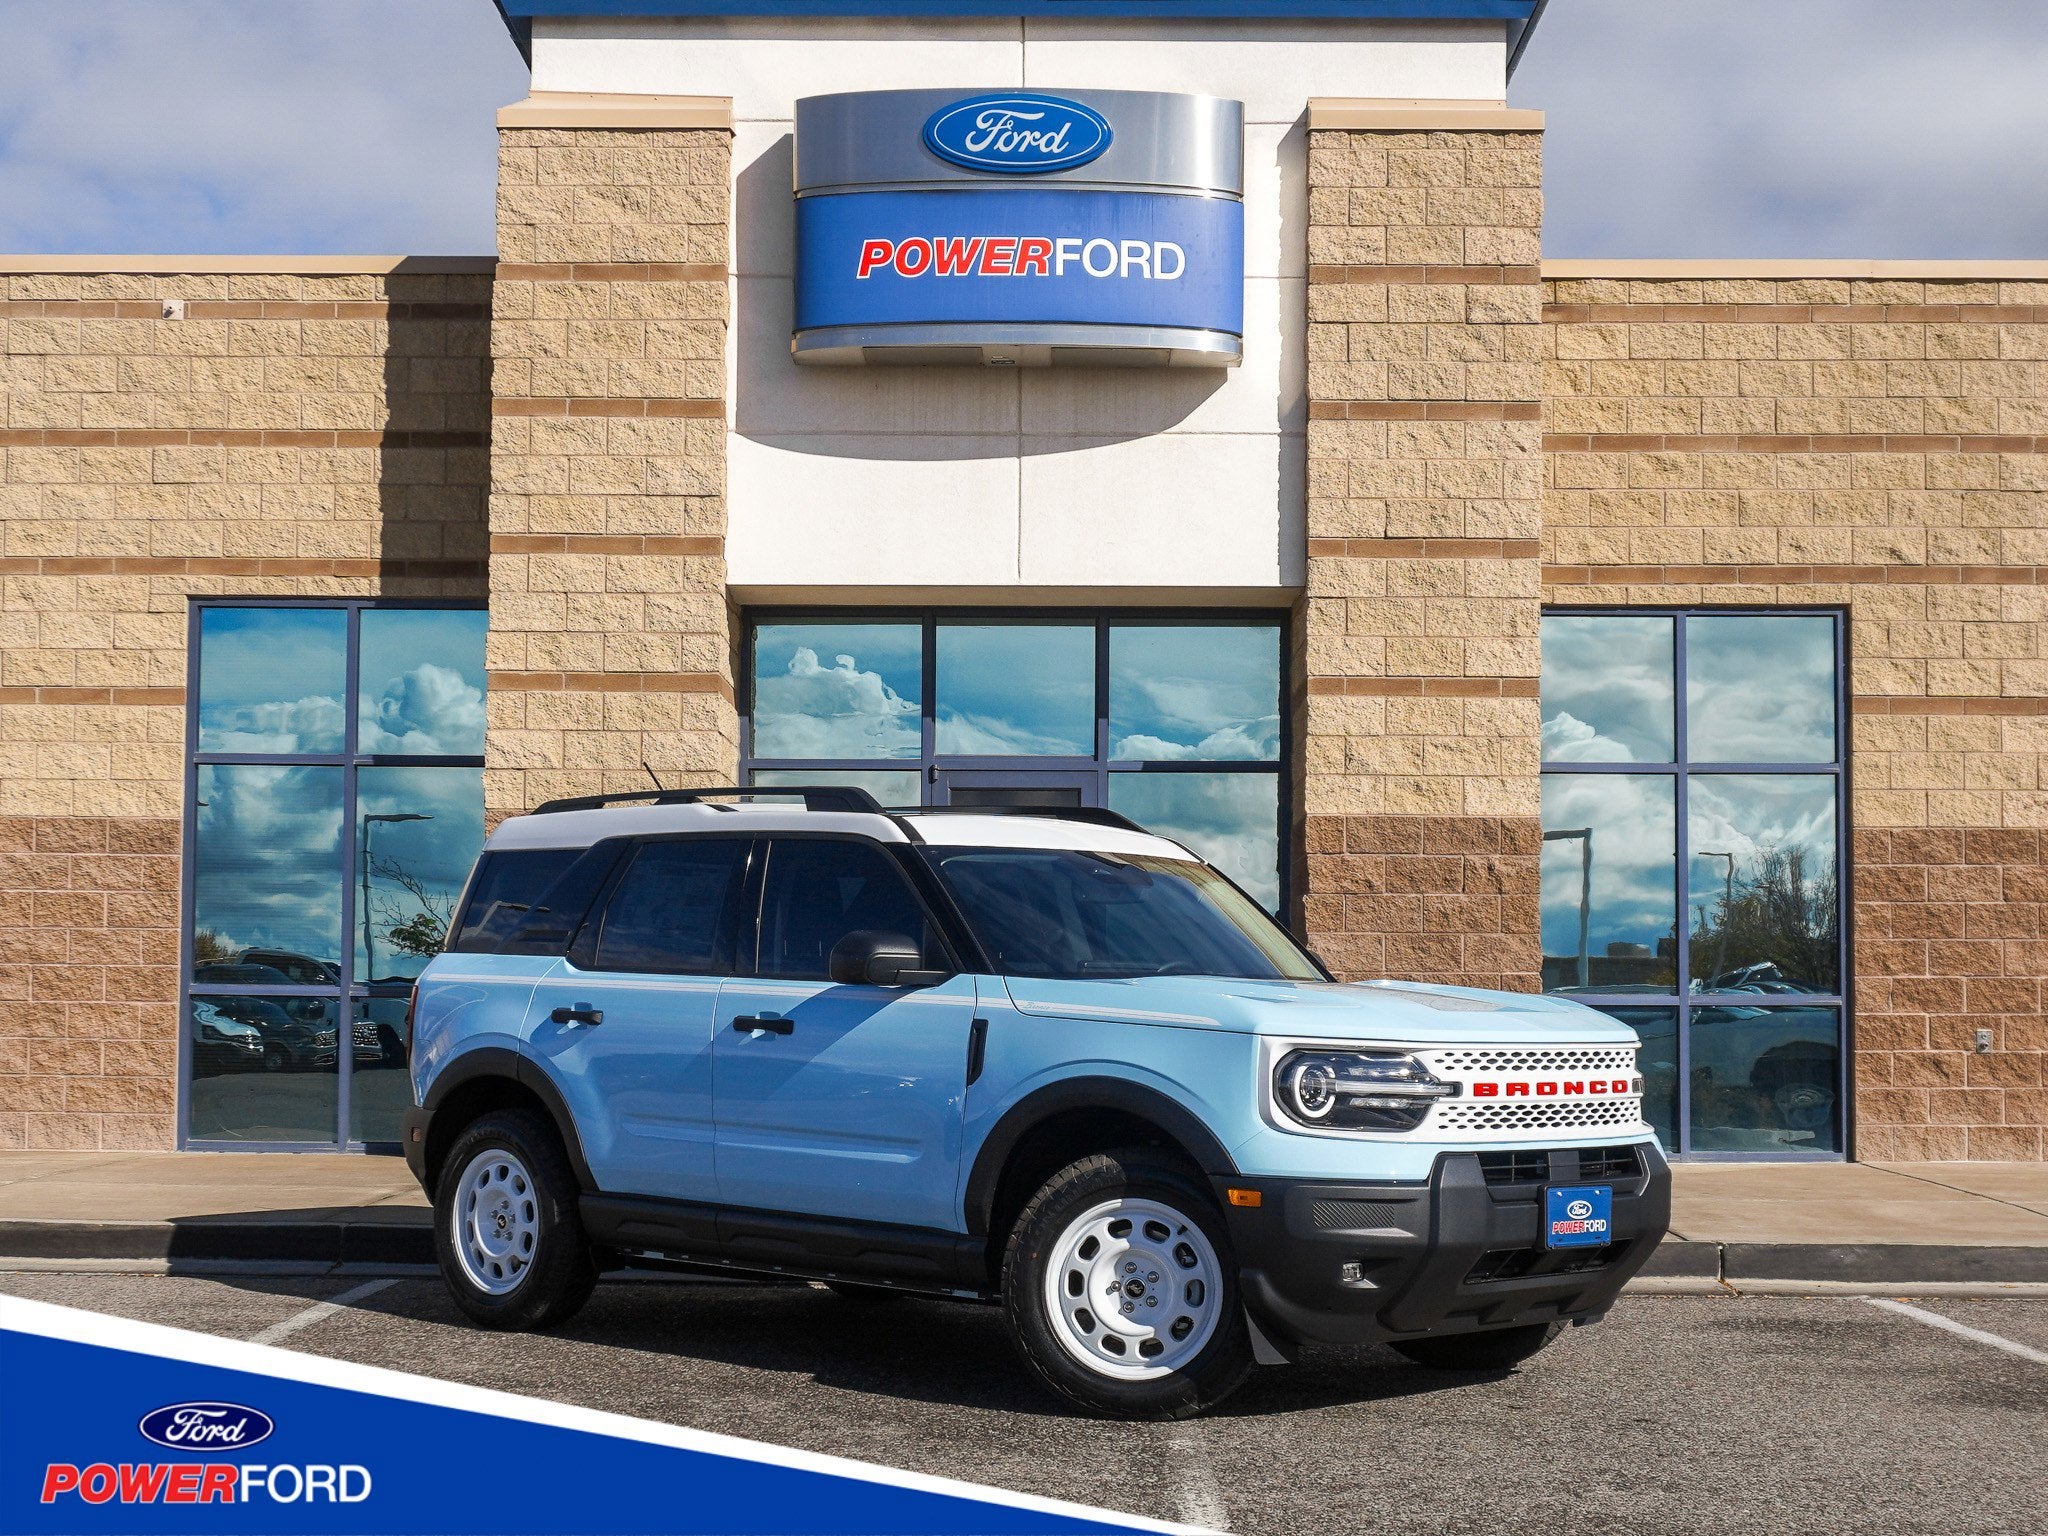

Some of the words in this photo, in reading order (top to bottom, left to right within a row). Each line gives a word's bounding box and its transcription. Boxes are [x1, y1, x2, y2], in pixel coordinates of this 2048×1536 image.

[965, 109, 1072, 154] Ford
[857, 237, 1186, 280] POWERFORD
[1473, 1079, 1628, 1097] BRONCO
[1551, 1219, 1607, 1235] POWERFORD
